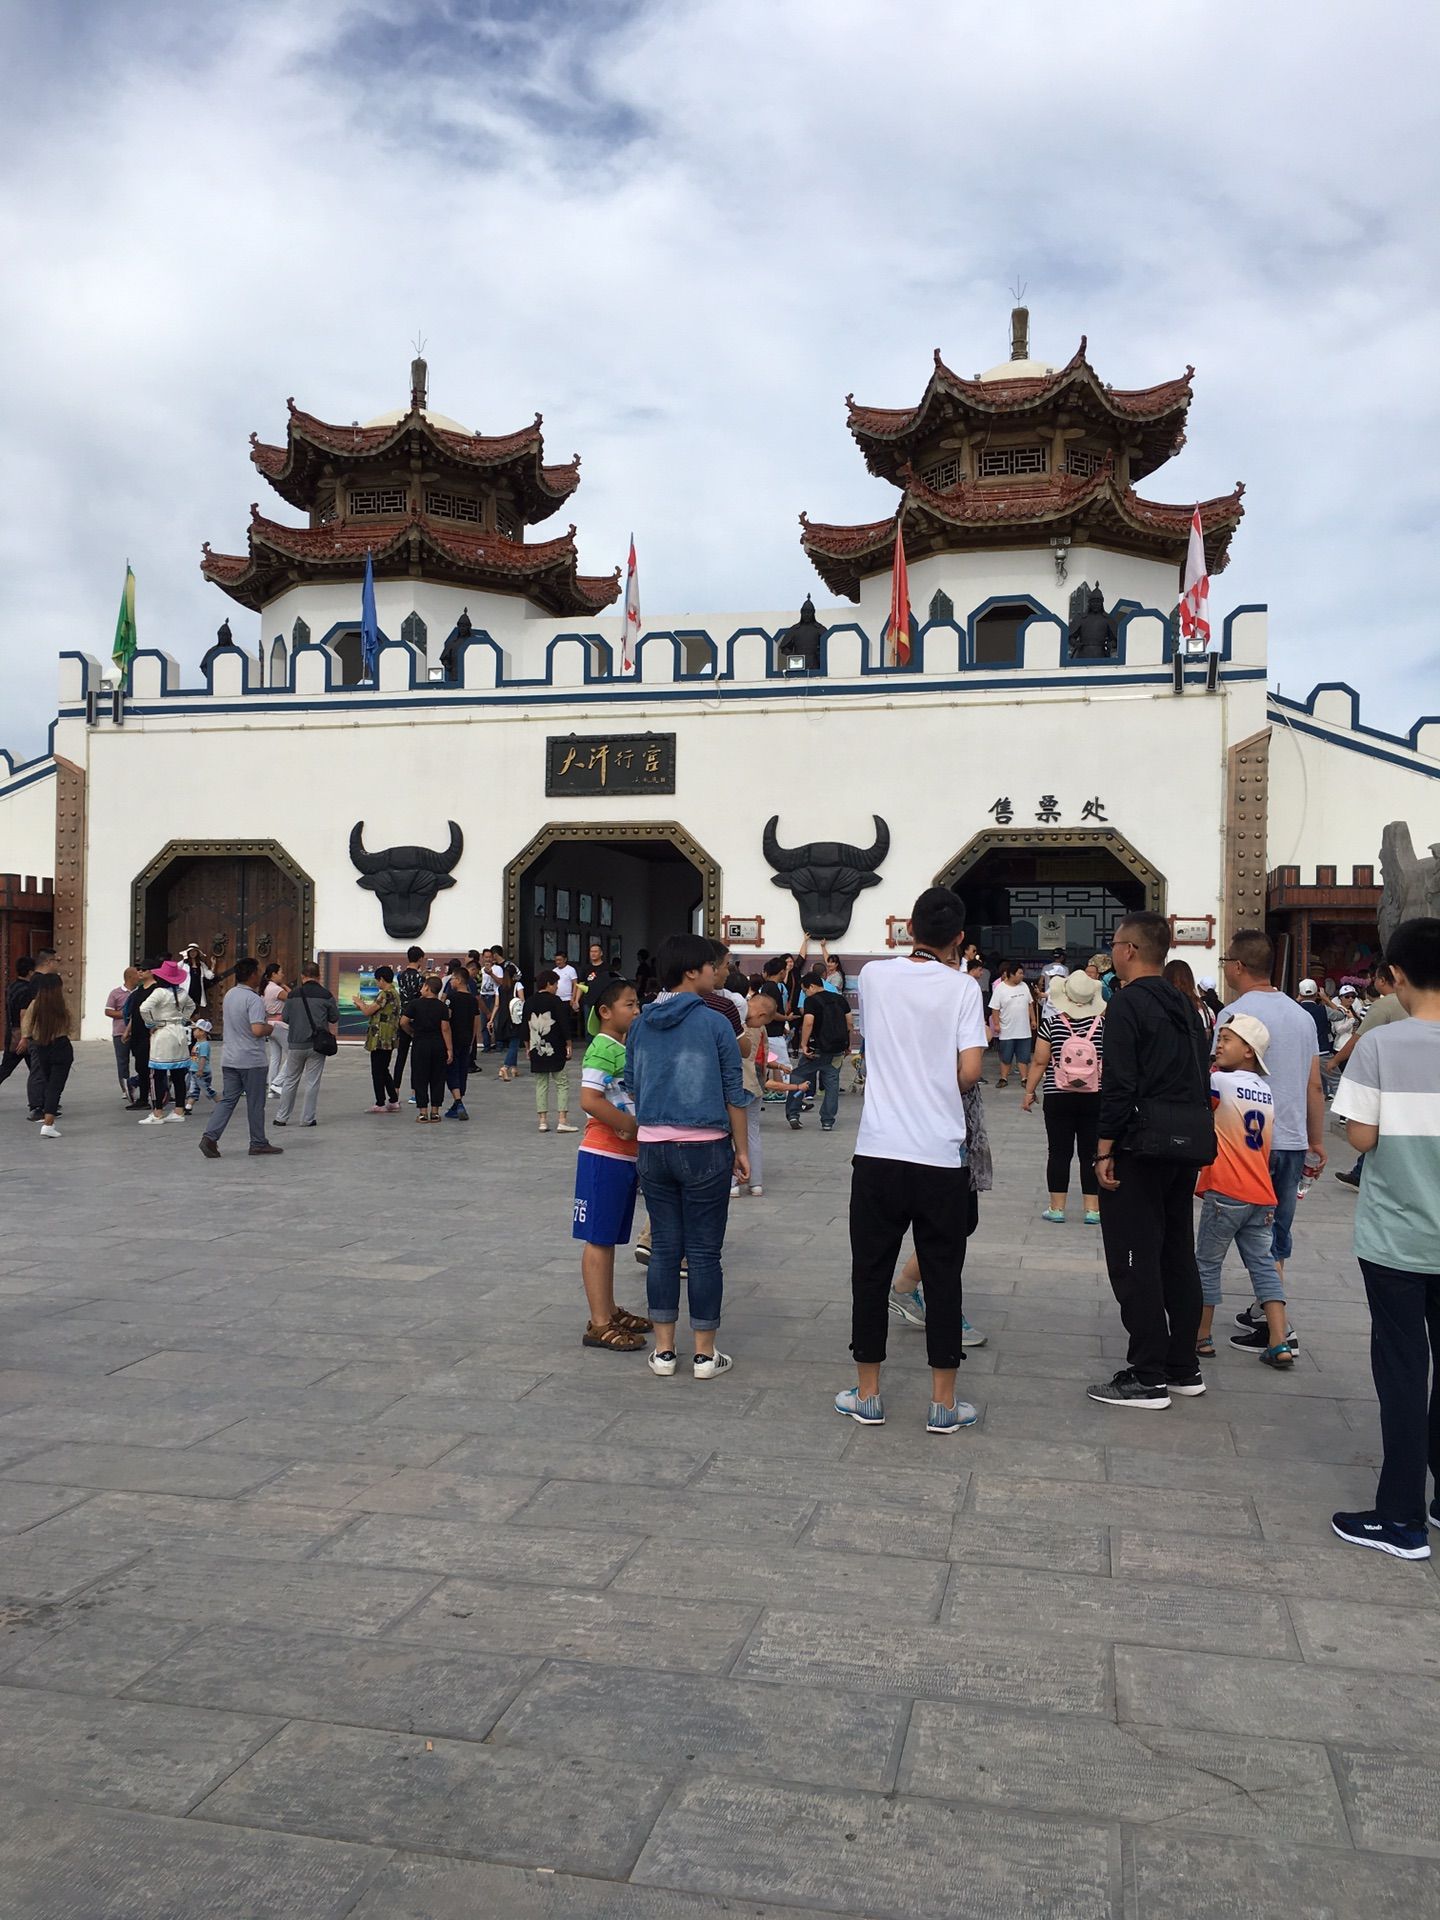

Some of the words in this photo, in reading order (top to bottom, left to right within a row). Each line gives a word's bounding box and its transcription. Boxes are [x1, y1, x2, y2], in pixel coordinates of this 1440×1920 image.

[988, 794, 1109, 825] 售票处
[914, 950, 936, 960] Canon
[1236, 1087, 1272, 1105] SOCCER
[1243, 1109, 1265, 1152] 9
[574, 1206, 587, 1223] 76
